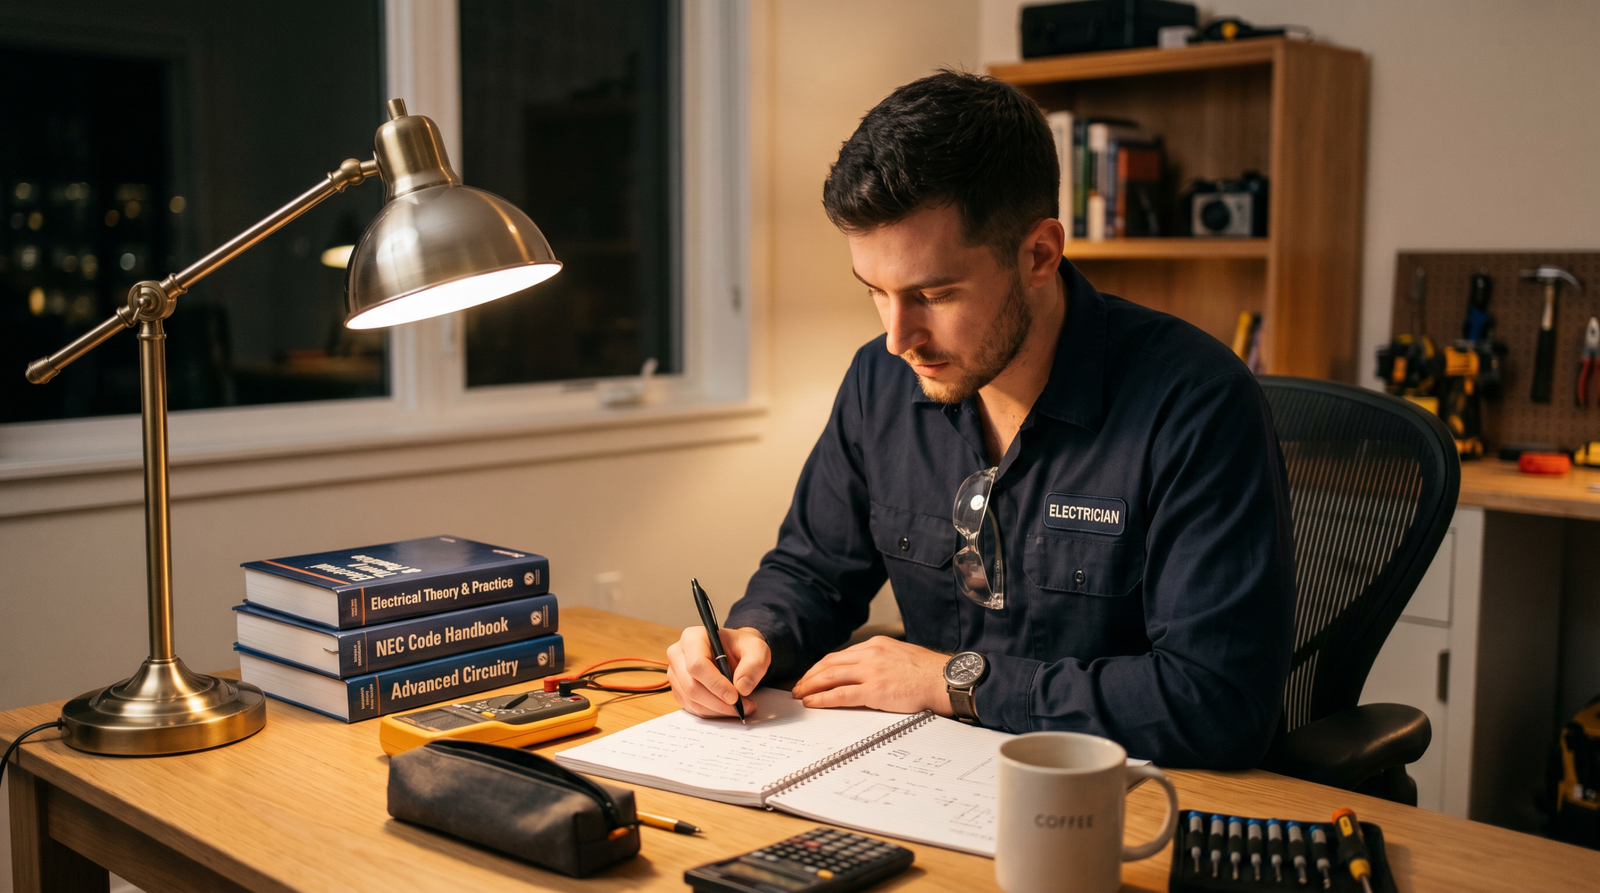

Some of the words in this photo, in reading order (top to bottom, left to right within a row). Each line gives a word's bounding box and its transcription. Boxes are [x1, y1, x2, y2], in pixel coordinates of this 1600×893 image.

[1049, 503, 1120, 525] ELECTRICIAN
[370, 589, 422, 611] Electrical
[423, 586, 460, 600] Theory
[461, 582, 470, 596] &
[472, 577, 514, 594] Practice
[375, 636, 405, 658] NEC
[408, 630, 442, 651] Code
[445, 616, 509, 644] Handbook
[391, 668, 460, 701] Advanced
[462, 659, 519, 684] Circuitry
[1034, 813, 1094, 830] COFFEE
